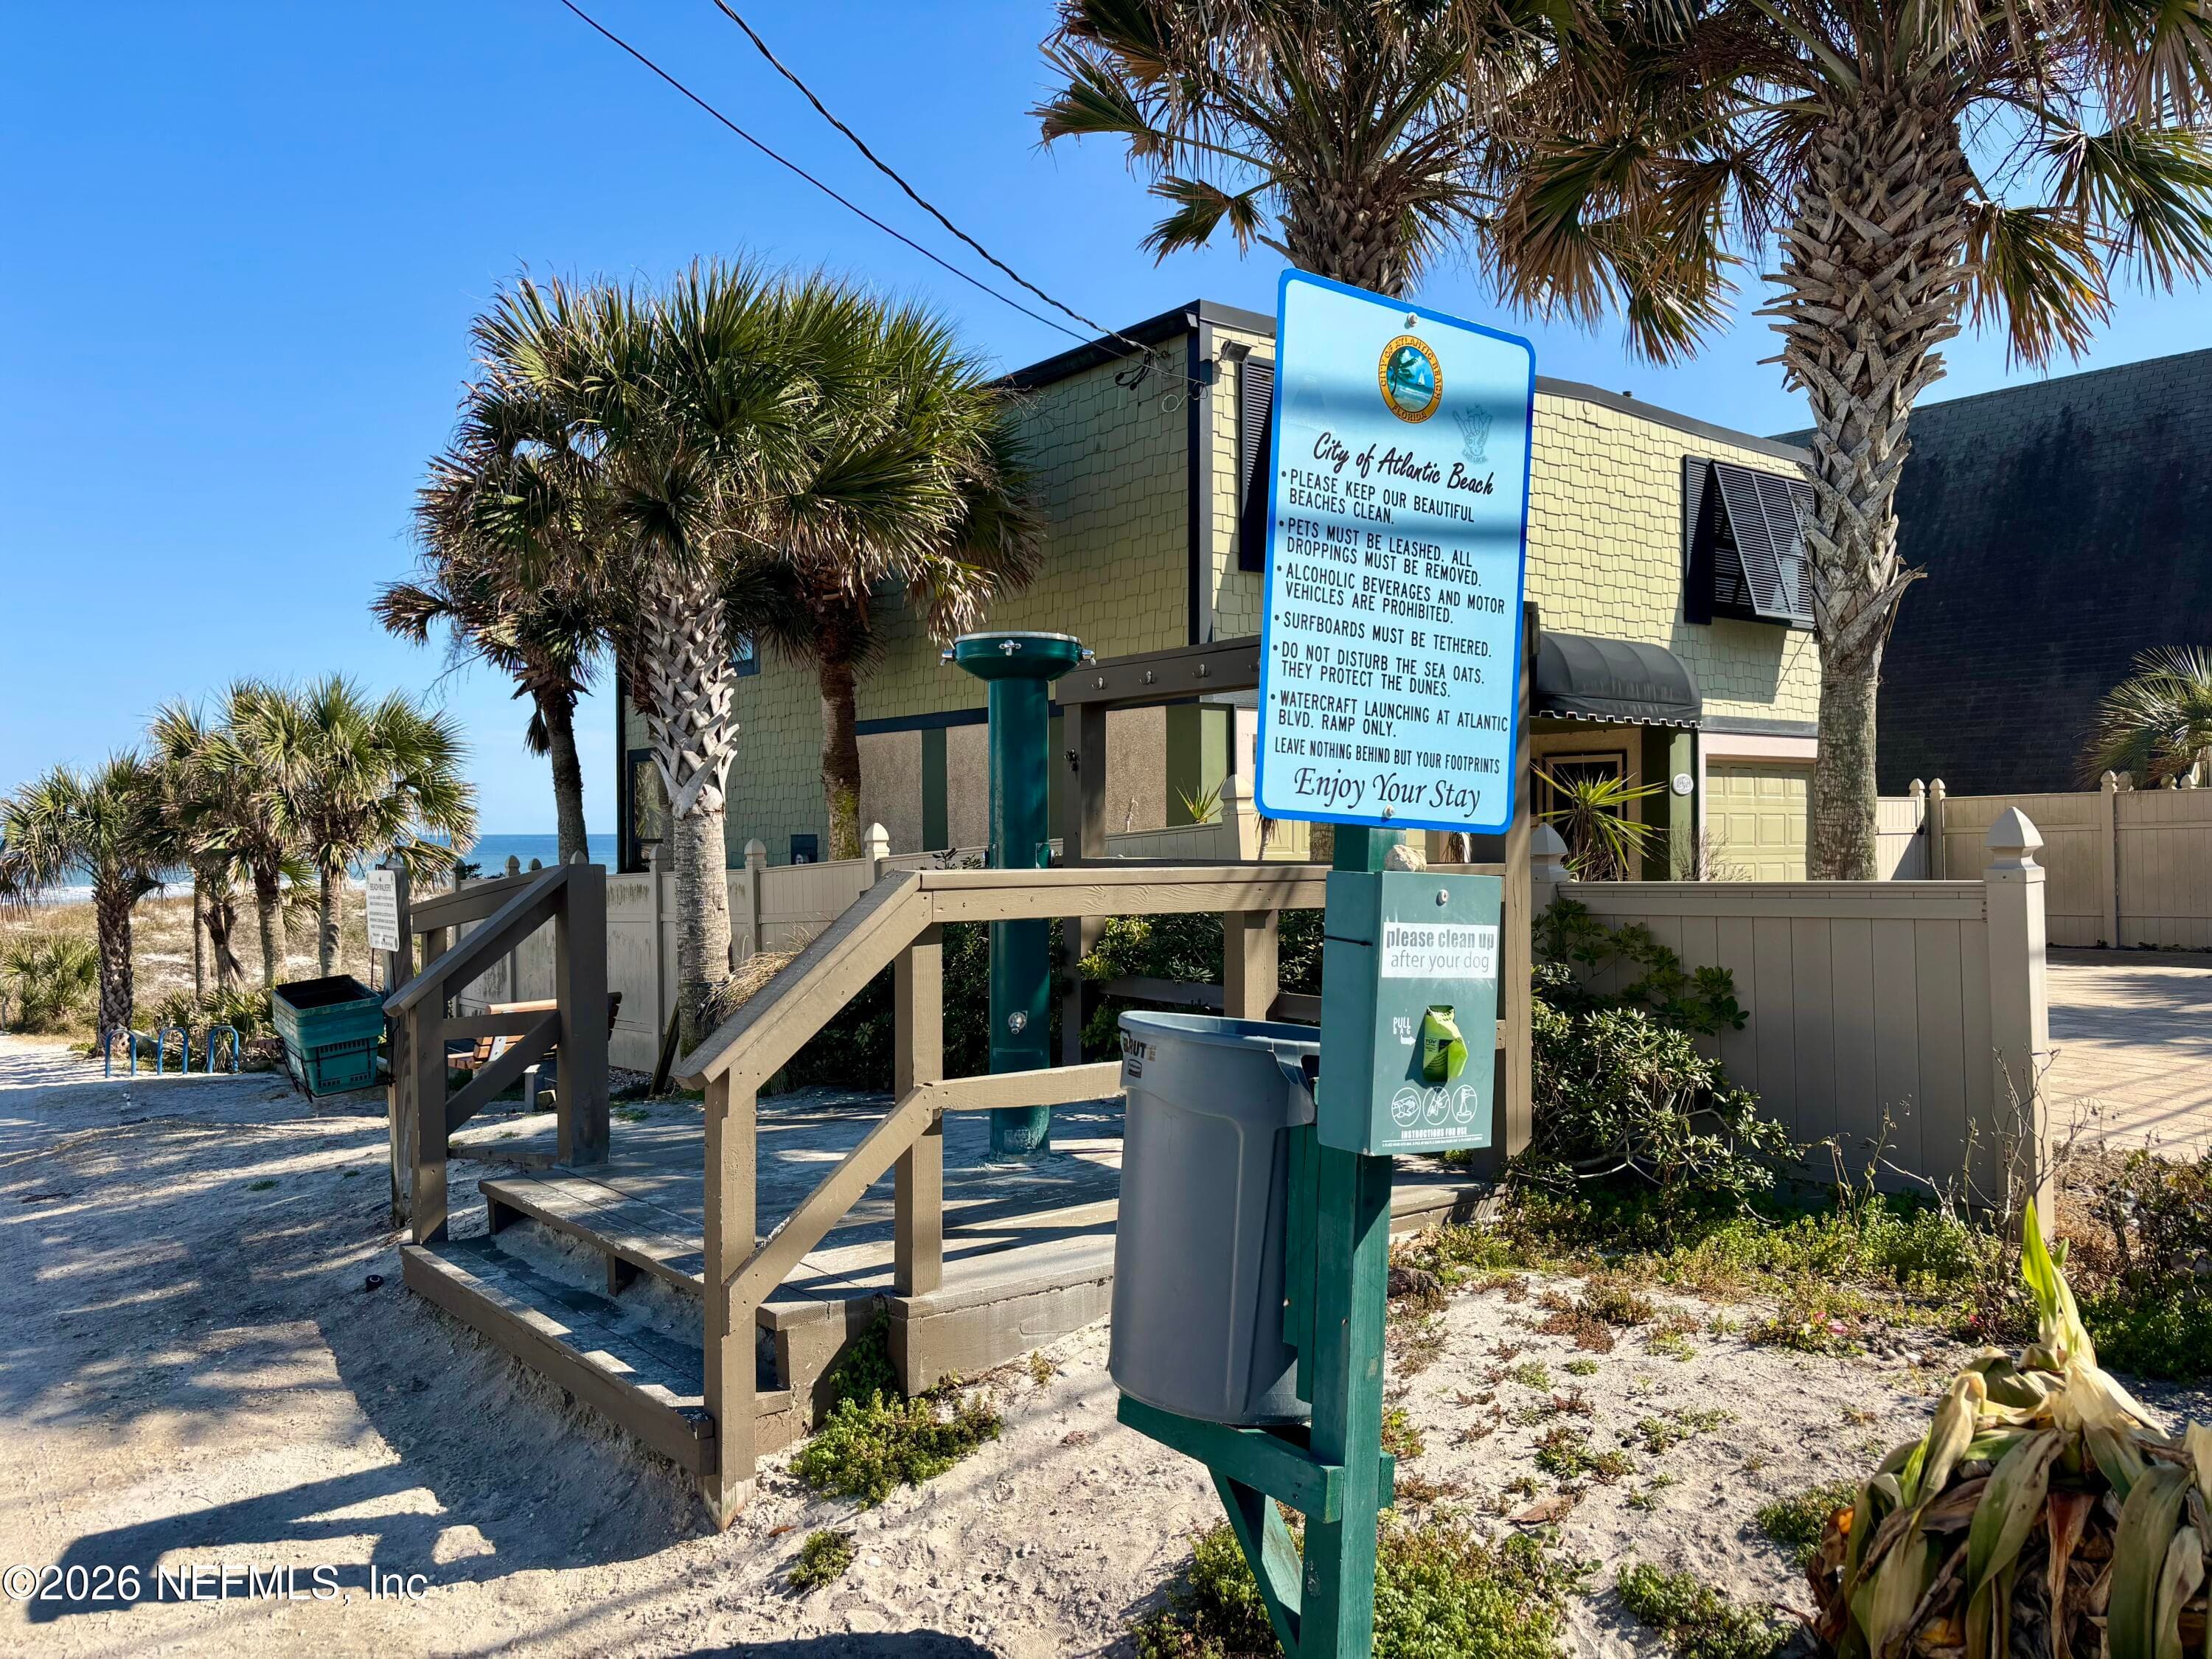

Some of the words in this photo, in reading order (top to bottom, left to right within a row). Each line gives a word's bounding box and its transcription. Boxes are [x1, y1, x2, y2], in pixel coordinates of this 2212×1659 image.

[1385, 344, 1394, 359] OF
[1395, 336, 1434, 361] ATLANTIC
[1433, 361, 1441, 400] BEACH
[1391, 405, 1427, 422] FLORIDA
[1313, 431, 1350, 474] City
[1355, 442, 1377, 479] of
[1377, 446, 1441, 484] Atlantic
[1446, 462, 1495, 495] Beach
[1289, 487, 1346, 515] BEACHES
[1353, 501, 1394, 525] CLEAN.
[1290, 468, 1338, 495] PLEASE
[1345, 480, 1376, 502] KEEP
[1382, 488, 1407, 509] OUR
[1413, 495, 1475, 523] BEAUTIFUL
[1287, 517, 1319, 539] PETS
[1326, 524, 1360, 546] MUST
[1366, 532, 1382, 551] BE
[1388, 536, 1444, 563] LEASHED.
[1451, 549, 1472, 568] ALL
[1287, 536, 1357, 565] DROPPINGS
[1364, 551, 1397, 572] MUST
[1403, 558, 1419, 576] BE
[1425, 561, 1481, 588] REMOVED.
[1285, 562, 1356, 590] ALCOHOLIC
[1362, 575, 1431, 602] BEVERAGES
[1437, 588, 1461, 607] AND
[1467, 594, 1505, 615] MOTOR
[1285, 580, 1344, 607] VEHICLES
[1352, 592, 1376, 611] ARE
[1382, 597, 1453, 625] PROHIBITED.
[1283, 611, 1366, 639] SURFBOARDS
[1372, 625, 1405, 645] MUST
[1411, 630, 1426, 648] BE
[1433, 633, 1492, 658] TETHERED.
[1281, 641, 1298, 659] DO
[1306, 644, 1331, 664] NOT
[1337, 648, 1388, 672] DISTURB
[1395, 657, 1418, 675] THE
[1424, 661, 1446, 679] SEA
[1453, 665, 1484, 685] OATS.
[1281, 659, 1313, 680] THEY
[1320, 664, 1374, 688] PROTECT
[1381, 673, 1403, 692] THE
[1409, 677, 1450, 698] DUNES.
[1278, 709, 1314, 729] BLVD.
[1321, 713, 1355, 733] RAMP
[1363, 718, 1397, 738] ONLY.
[1280, 689, 1358, 714] WATERCRAFT
[1364, 700, 1430, 723] LAUNCHING
[1436, 709, 1450, 726] AT
[1456, 712, 1508, 732] ATLANTIC
[1275, 736, 1306, 756] LEAVE
[1310, 740, 1352, 760] NOTHING
[1355, 745, 1391, 764] BEHIND
[1394, 748, 1413, 766] BUT
[1416, 751, 1441, 769] YOUR
[1444, 754, 1500, 774] FOOTPRINTS
[1294, 767, 1366, 810] Enjoy
[1372, 772, 1427, 804] Your
[1428, 779, 1481, 818] Stay
[1386, 928, 1434, 948] please
[1439, 929, 1475, 948] clean
[1478, 933, 1495, 950] up
[1391, 950, 1425, 968] after
[1429, 956, 1461, 973] your
[1464, 951, 1489, 973] dog
[1393, 1016, 1411, 1029] PULL
[1401, 1128, 1444, 1139] INSTRUCTIONS
[1445, 1127, 1456, 1136] FOR
[1456, 1127, 1467, 1135] USE
